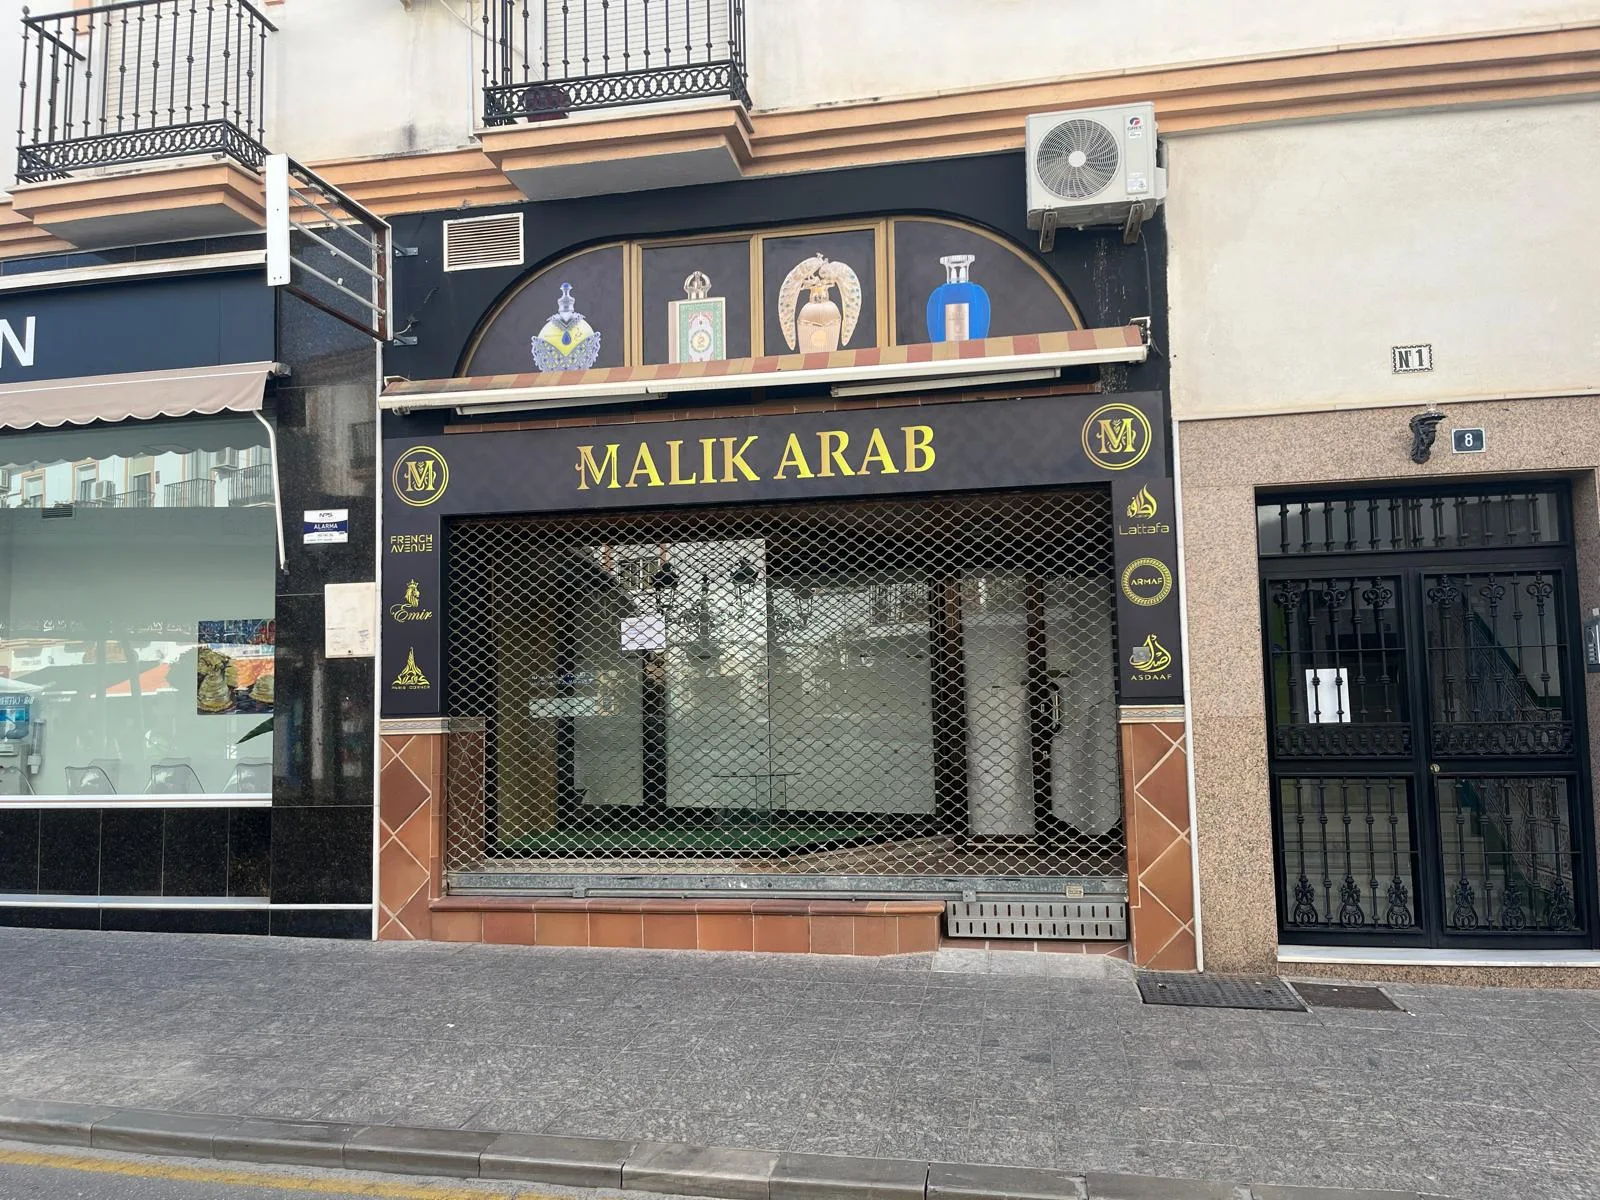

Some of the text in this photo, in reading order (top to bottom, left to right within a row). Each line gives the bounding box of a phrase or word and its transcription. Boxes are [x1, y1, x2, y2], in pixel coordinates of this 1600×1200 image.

[1464, 433, 1474, 447] 8
[575, 425, 936, 490] MALIK ARAB
[1119, 522, 1170, 536] Lattafa
[390, 534, 433, 544] FRENCH
[390, 543, 433, 553] AVENUE
[1131, 577, 1163, 586] ARMAF
[389, 603, 433, 623] Emir
[1130, 673, 1172, 681] ASDAAF
